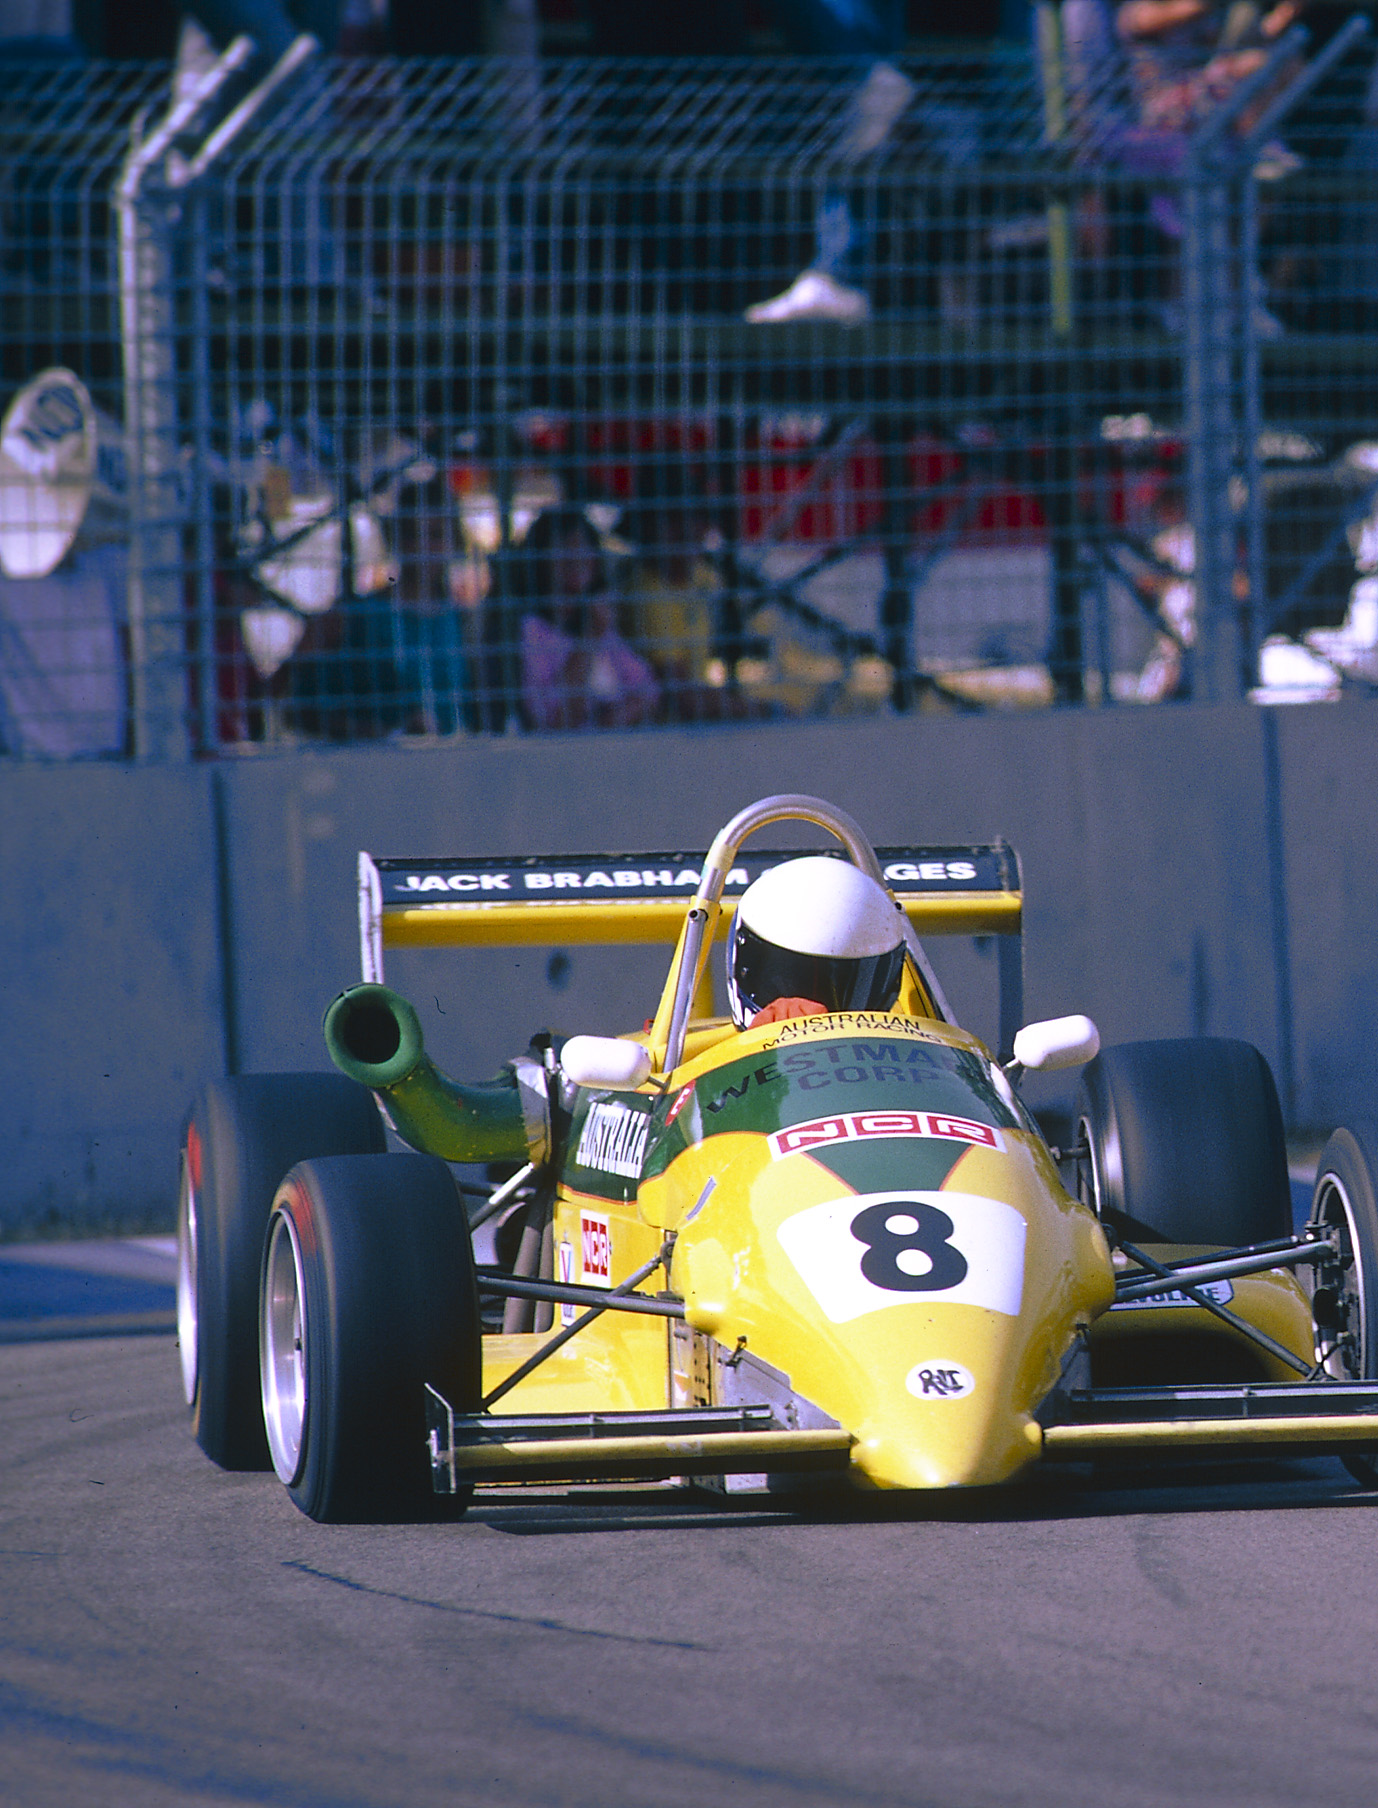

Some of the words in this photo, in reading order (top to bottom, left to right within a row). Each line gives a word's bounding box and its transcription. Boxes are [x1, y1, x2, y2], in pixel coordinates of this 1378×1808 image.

[394, 873, 512, 892] JACK
[762, 1023, 845, 1050] MOTOR
[856, 1022, 945, 1044] RACING
[779, 1013, 921, 1036] AUSTRALIAN
[797, 1065, 941, 1091] CORP
[776, 1114, 997, 1154] NCR
[582, 1222, 608, 1273] NCR
[849, 1200, 969, 1292] 8
